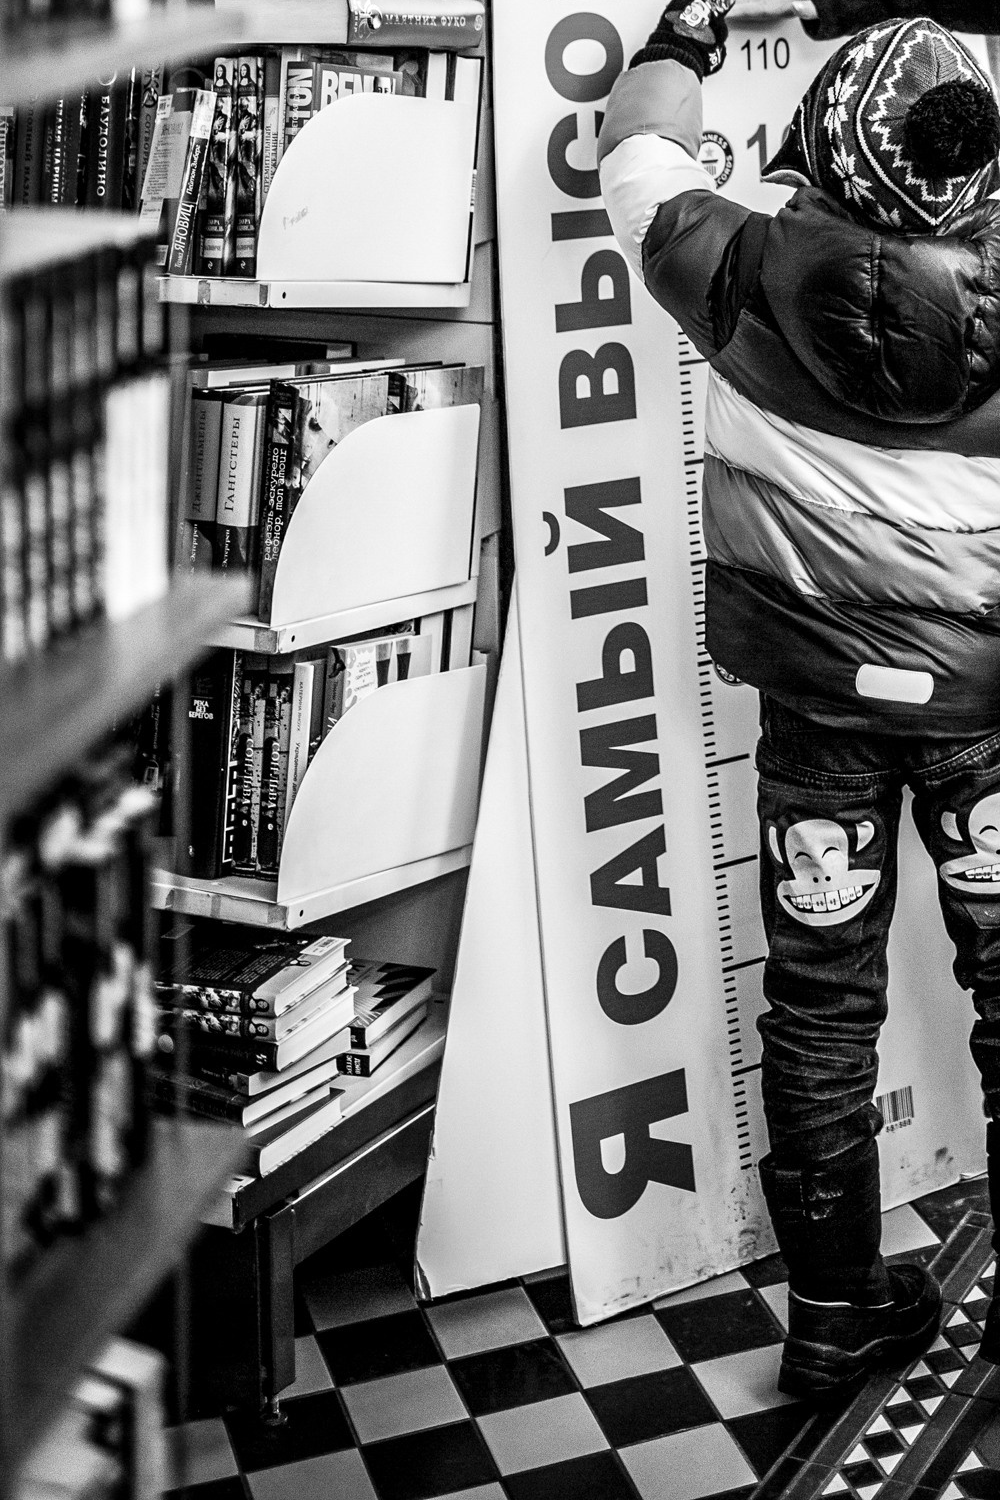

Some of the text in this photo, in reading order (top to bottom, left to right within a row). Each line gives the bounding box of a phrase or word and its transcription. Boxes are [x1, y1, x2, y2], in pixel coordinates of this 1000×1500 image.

[385, 13, 467, 28] МАЯТНИК ФУКО
[740, 37, 792, 72] 110
[96, 95, 110, 197] БАУДОЛИНО
[190, 144, 202, 173] Эмберг
[185, 171, 196, 195] Пейтон
[174, 202, 196, 253] ЯНОВИЦ
[278, 448, 288, 486] amour
[264, 447, 279, 561] рафаэль эскуредо
[275, 488, 284, 511] mon
[188, 710, 214, 719] БЕРЕГОВ
[542, 476, 680, 1027] САМЫЙ
[569, 1068, 697, 1221] Я
